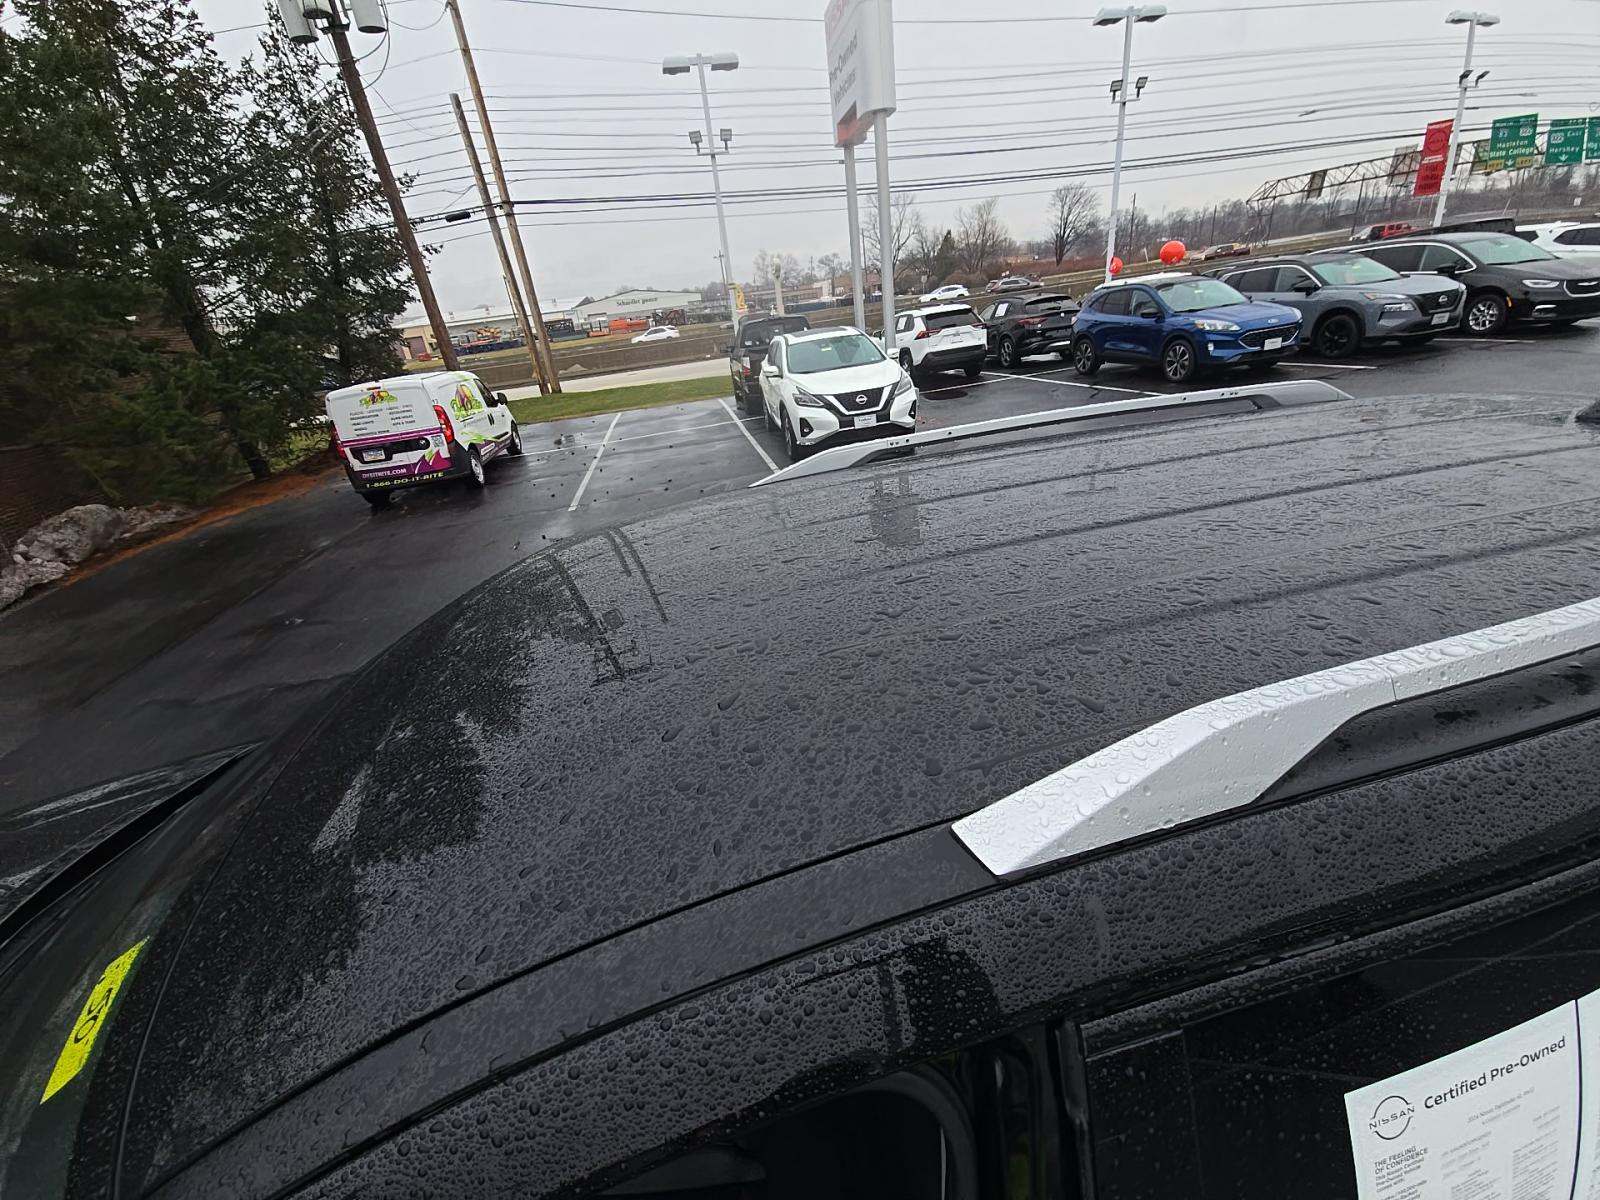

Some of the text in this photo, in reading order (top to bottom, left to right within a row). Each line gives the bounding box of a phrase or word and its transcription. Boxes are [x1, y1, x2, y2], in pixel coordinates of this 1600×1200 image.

[1424, 1073, 1487, 1109] Certified
[1490, 1036, 1566, 1082] Pre-Owned
[1368, 1105, 1415, 1131] NISSAN
[1374, 1146, 1416, 1169] THE FEELING
[1375, 1167, 1385, 1175] OF
[1386, 1147, 1428, 1170] CONFIDENCE
